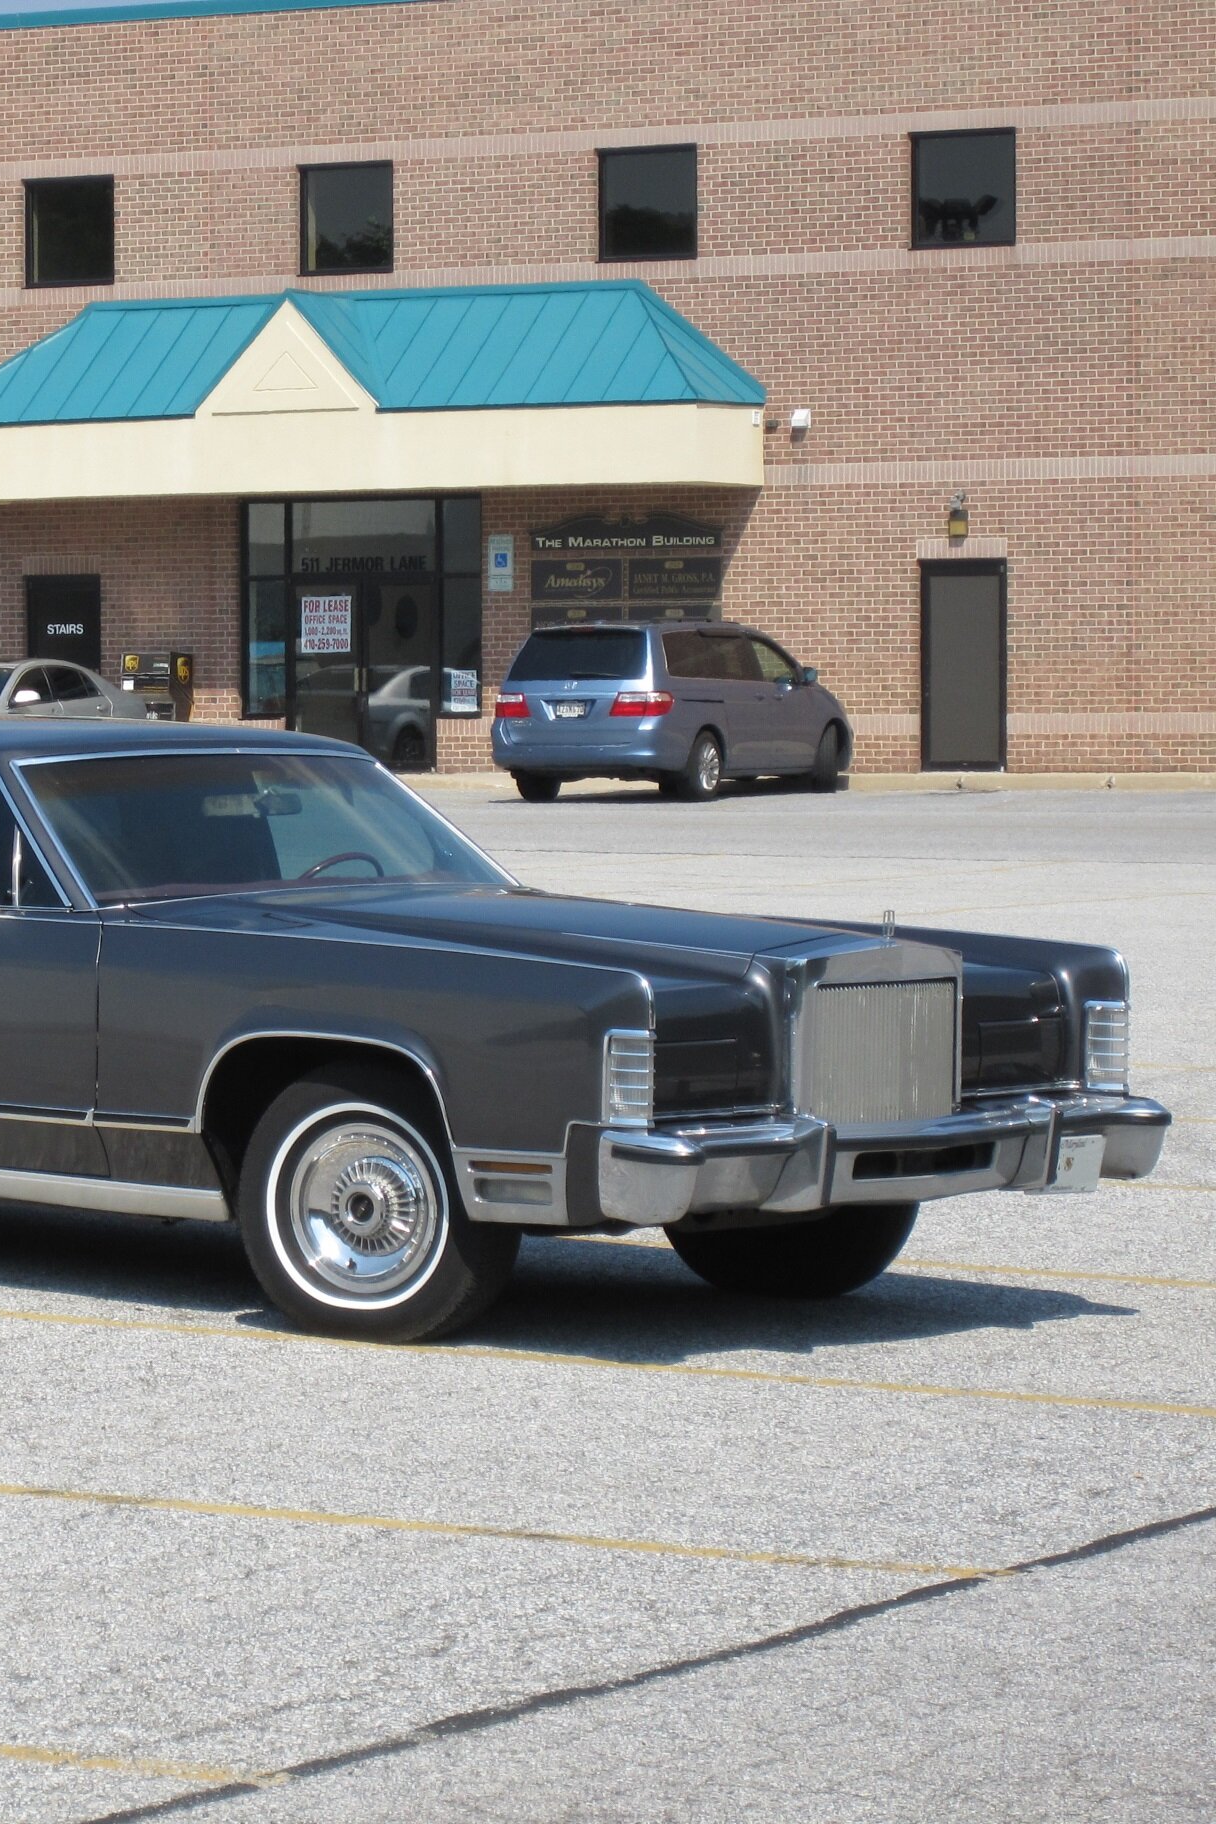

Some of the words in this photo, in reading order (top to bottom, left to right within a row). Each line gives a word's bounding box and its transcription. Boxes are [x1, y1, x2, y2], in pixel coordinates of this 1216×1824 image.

[568, 536, 646, 548] MARATHON
[652, 535, 715, 547] BUILDING
[301, 557, 320, 573] 511
[325, 556, 384, 572] JERMOR
[390, 555, 426, 570] LANE
[304, 600, 320, 613] FOR
[323, 599, 349, 613] LEASE
[304, 615, 326, 625] OFFICE
[328, 614, 348, 624] SPACE
[47, 623, 84, 635] STAIRS
